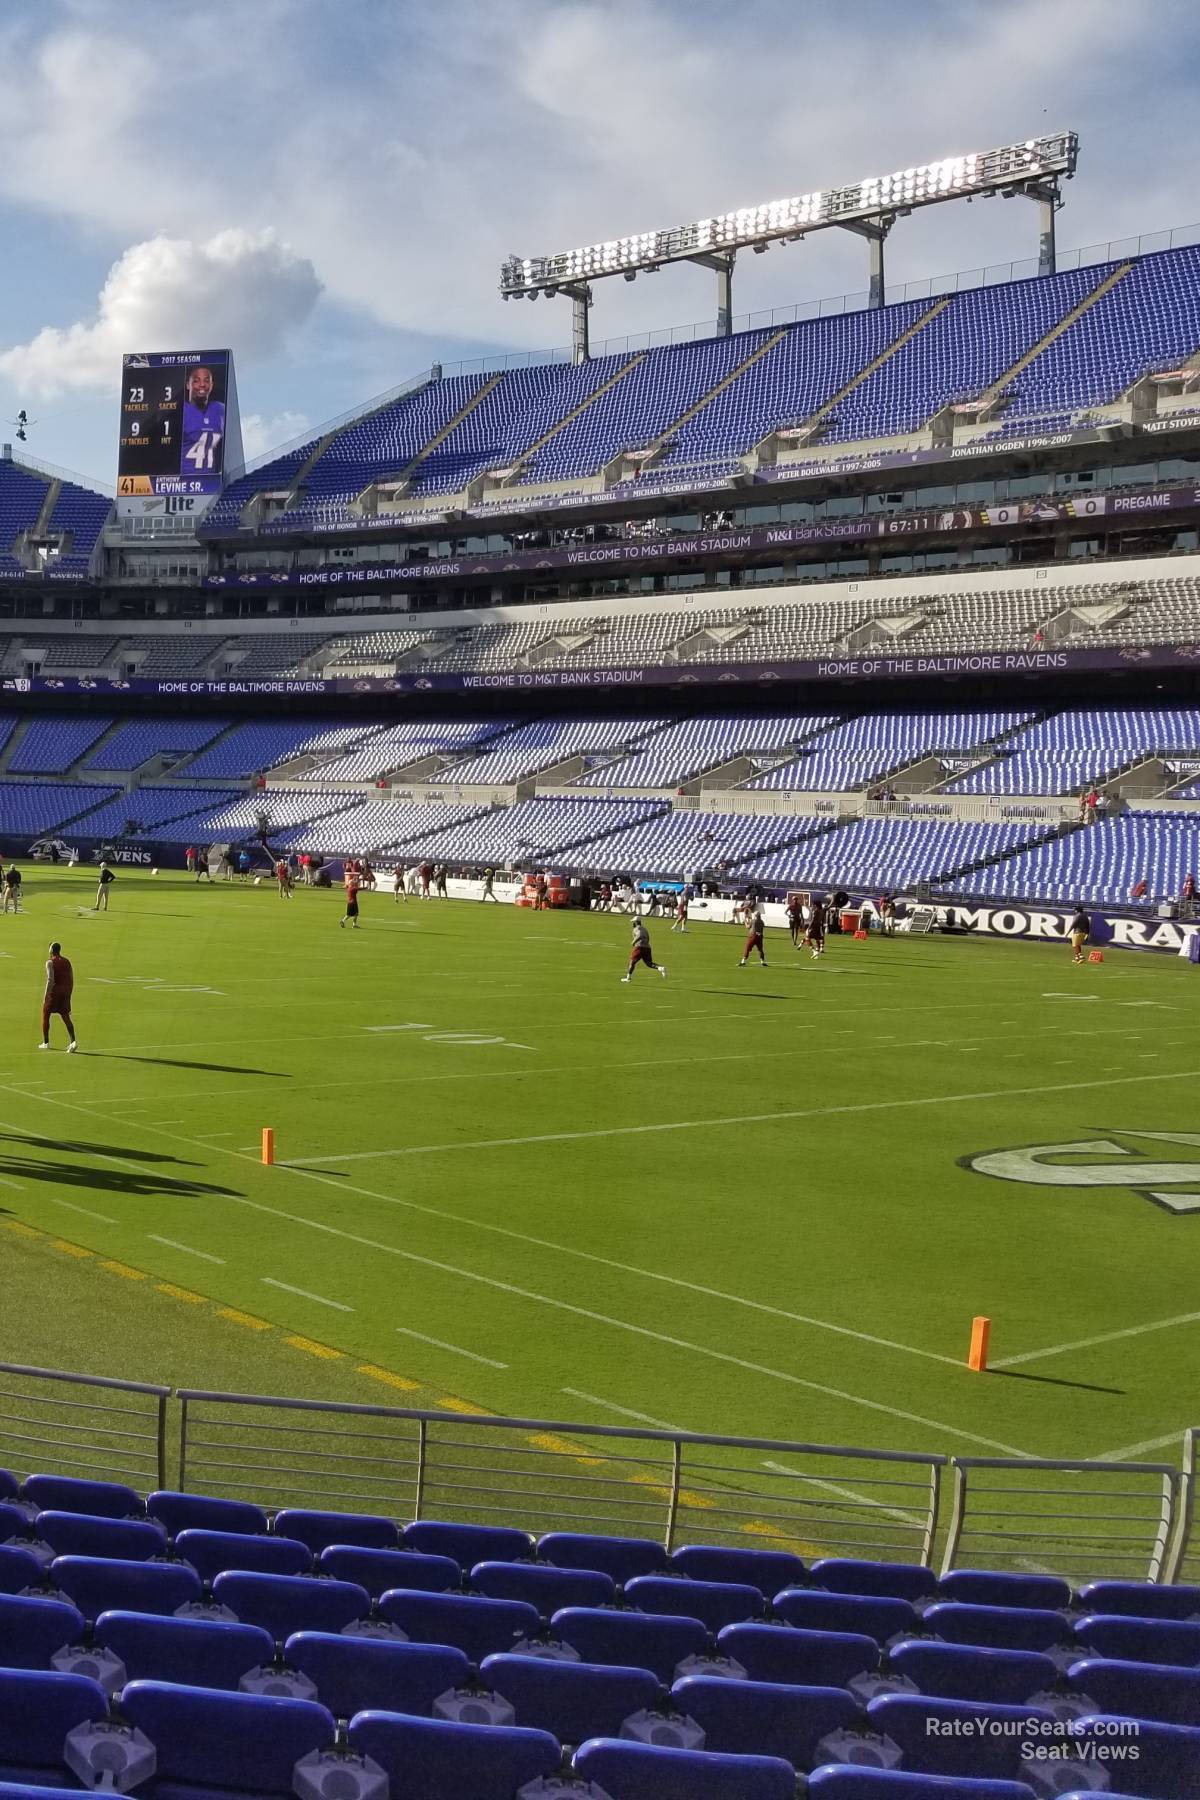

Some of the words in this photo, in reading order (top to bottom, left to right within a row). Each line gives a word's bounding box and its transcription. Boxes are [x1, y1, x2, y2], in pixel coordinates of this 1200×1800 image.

[162, 356, 175, 364] 2017
[177, 355, 200, 363] SEASON
[129, 388, 144, 402] 23
[164, 387, 172, 401] 3
[158, 402, 177, 410] SACKS
[132, 422, 140, 436] 9
[163, 421, 169, 435] 1
[1142, 421, 1168, 432] MATT
[185, 432, 221, 469] 41
[950, 443, 993, 458] JONATHAN
[995, 440, 1024, 452] OGDEN
[1027, 434, 1072, 447] 1996-2007
[777, 469, 800, 480] PETER
[801, 464, 840, 477] BOULWARE
[842, 459, 881, 471] 1997-2005
[121, 478, 134, 493] 41
[156, 483, 188, 493] LEVINE
[189, 482, 204, 493] SR.
[632, 487, 660, 497] MICHAEL
[662, 484, 692, 495] McCRARY
[163, 496, 195, 515] Lite
[558, 496, 583, 506] ARTHUR
[591, 493, 617, 502] MODELL
[1086, 500, 1097, 513] 0
[1114, 494, 1170, 511] PREGAME
[997, 510, 1009, 522] 0
[888, 518, 928, 532] 67:11
[795, 527, 823, 540] Bank
[568, 549, 621, 563] WELCOME
[623, 547, 639, 558] TO
[641, 544, 665, 556] M&T
[668, 541, 698, 554] BANK
[701, 536, 751, 551] STADIUM
[299, 572, 326, 583] HOME
[328, 571, 342, 582] OF
[345, 570, 364, 581] THE
[367, 566, 421, 580] BALTIMORE
[423, 563, 460, 576] RAVENS
[818, 663, 859, 675] HOME
[862, 661, 881, 674] OF
[885, 660, 913, 673] THE
[917, 656, 1001, 672] BALTIMORE
[1005, 653, 1068, 669] RAVENS
[158, 682, 186, 692] HOME
[190, 682, 204, 692] OF
[207, 682, 227, 692] THE
[229, 681, 284, 692] BALTIMORE
[286, 680, 325, 691] RAVENS
[463, 675, 515, 687] WELCOME
[518, 674, 533, 685] TO
[535, 674, 557, 685] M&T
[561, 672, 590, 684] BANK
[593, 671, 643, 683] STADIUM
[92, 849, 152, 864] VENS
